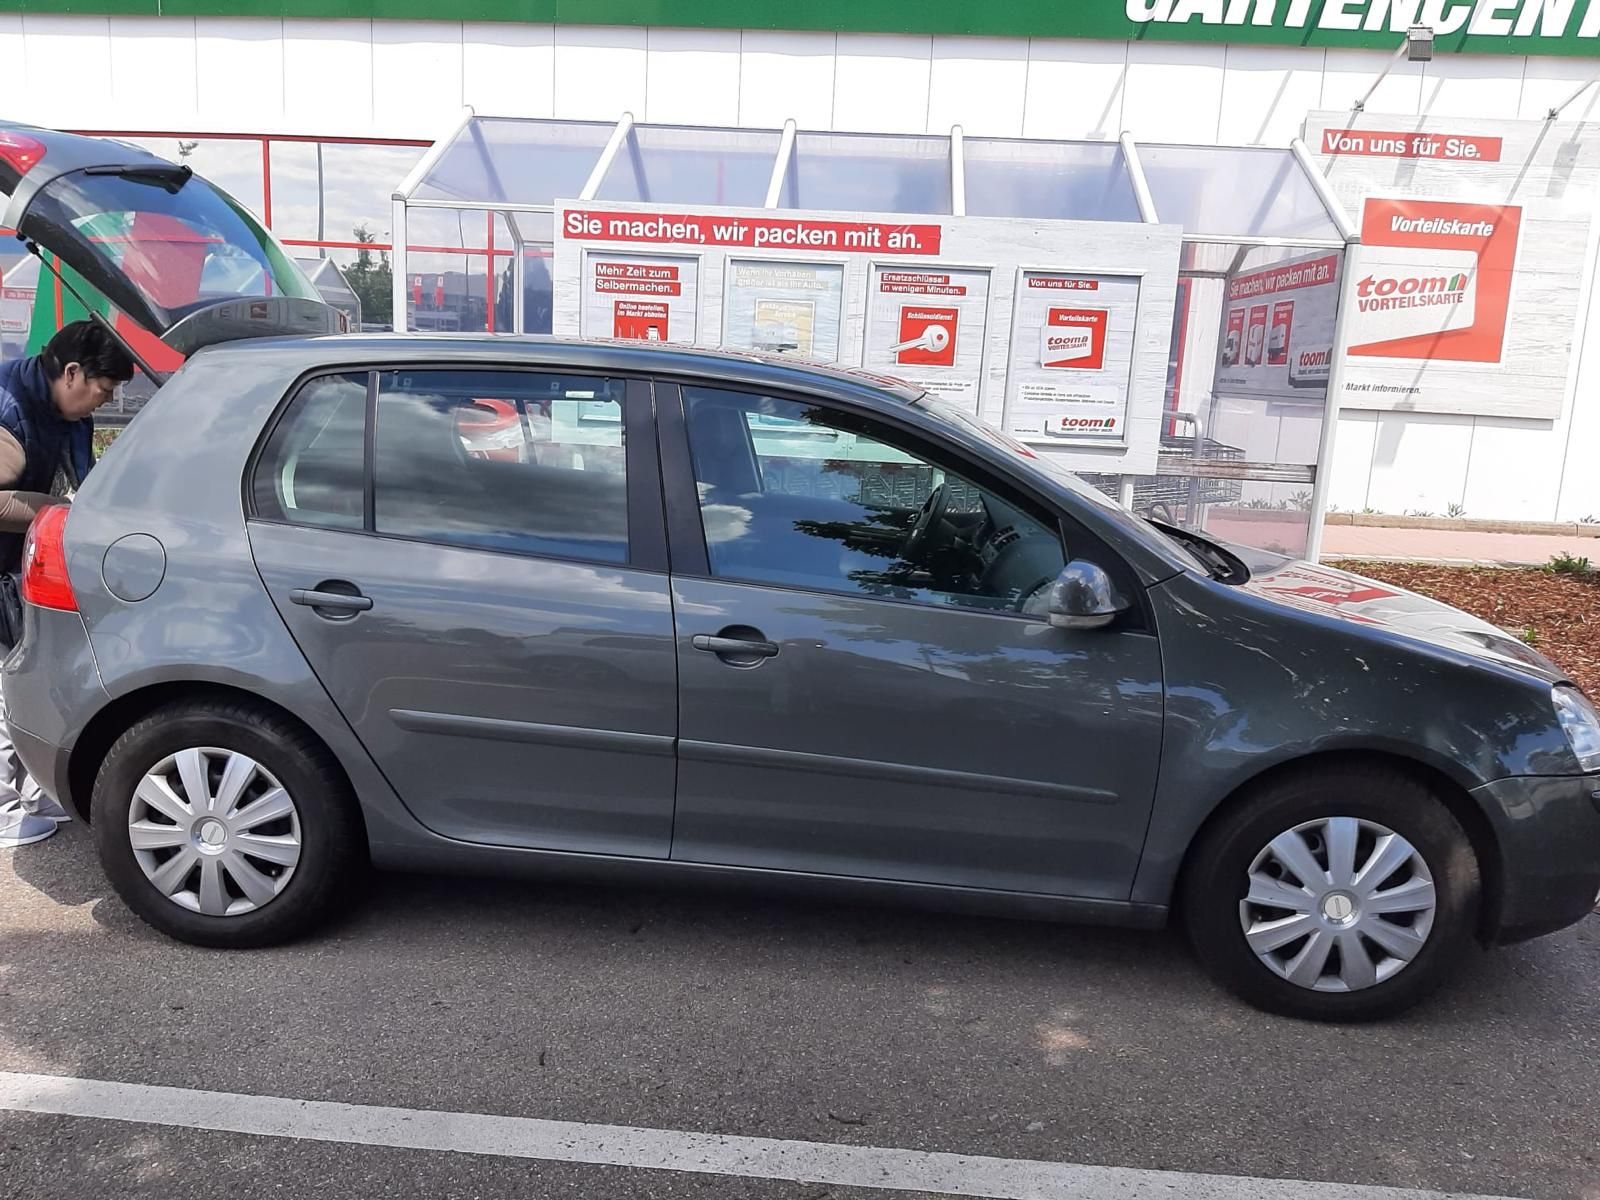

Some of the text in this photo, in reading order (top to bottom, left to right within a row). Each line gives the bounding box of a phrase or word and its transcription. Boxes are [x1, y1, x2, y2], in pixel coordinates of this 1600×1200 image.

[1326, 133, 1481, 159] Von uns für Sie.
[567, 212, 922, 249] Sie machen, wir packen mit an.
[1391, 215, 1494, 237] Vorteilskarte
[597, 265, 671, 278] Mehr Zeit zum
[1276, 265, 1302, 292] packen
[1303, 263, 1316, 283] mit
[1316, 263, 1329, 280] an.
[883, 273, 945, 284] Ersatzschlüssel
[1030, 279, 1093, 289] Von uns für Sie.
[596, 279, 673, 293] Selbermachen.
[891, 286, 925, 295] wenigen
[926, 286, 961, 295] Minuten.
[1357, 274, 1447, 298] toom
[1358, 292, 1464, 312] VORTEILSKARTE
[1059, 314, 1098, 323] Vorteilskarte
[1048, 335, 1080, 346] toom
[1300, 350, 1325, 366] toom
[1371, 384, 1422, 394] informieren.
[1062, 417, 1104, 427] toom
